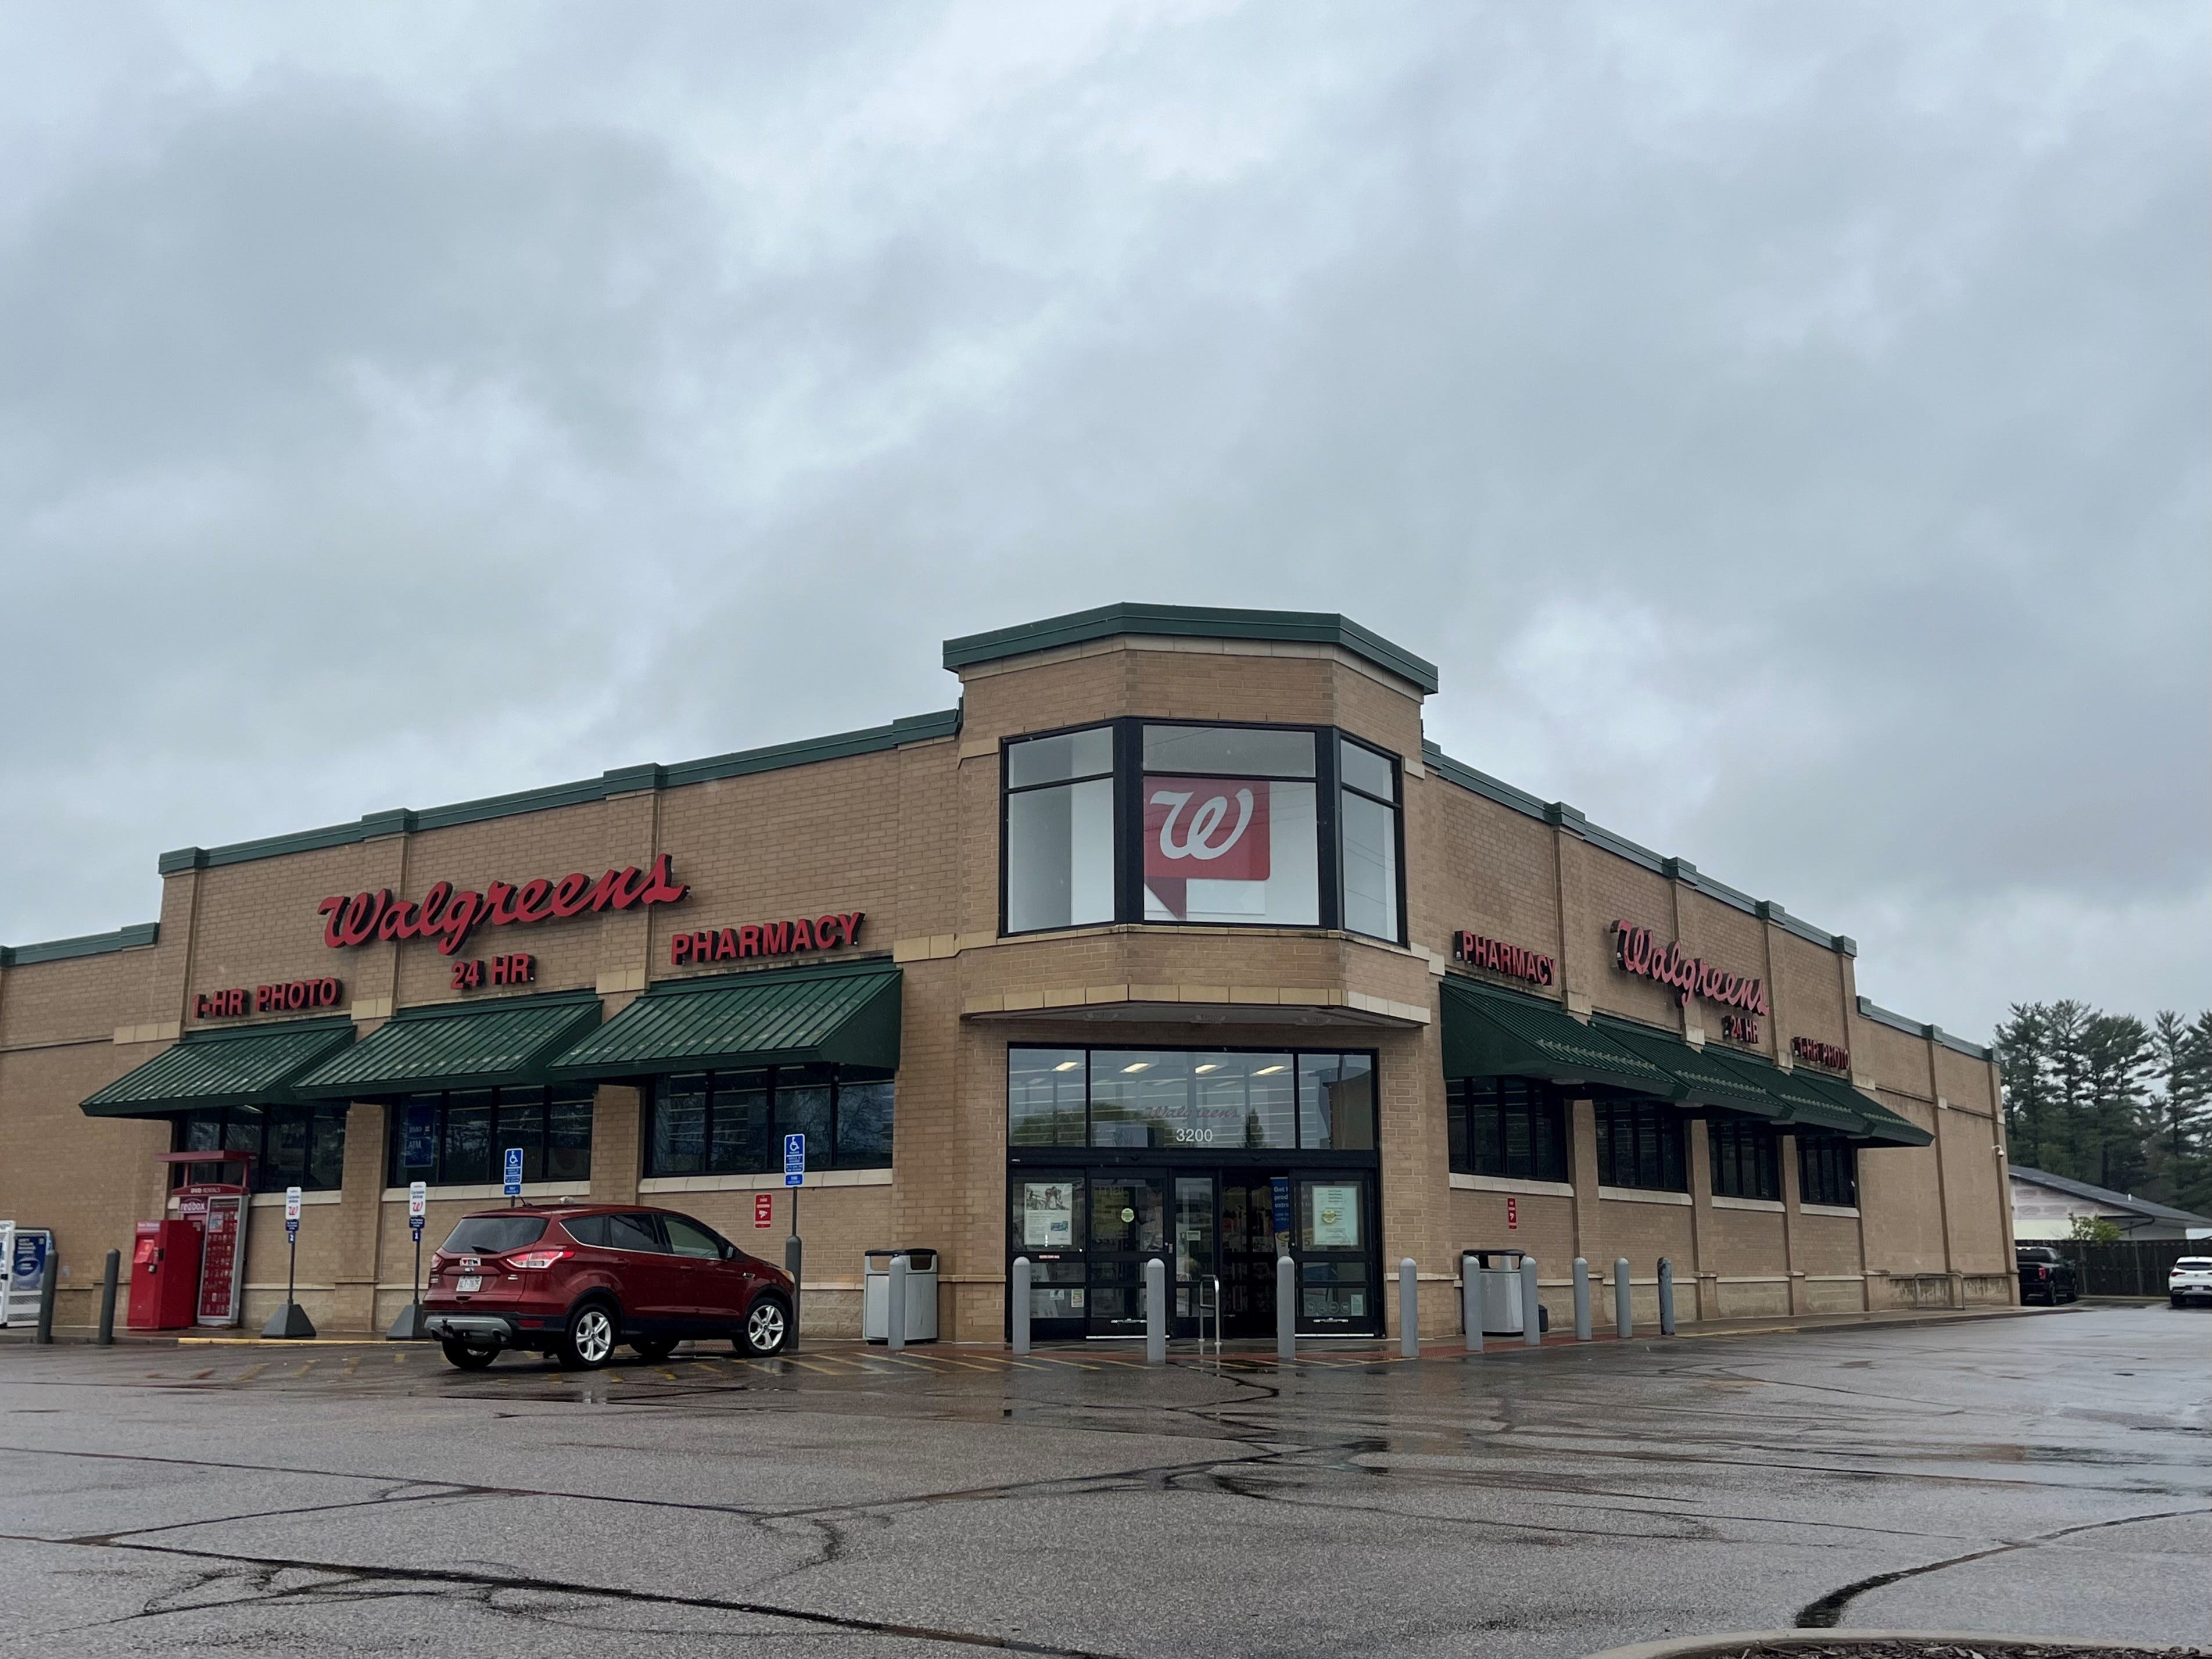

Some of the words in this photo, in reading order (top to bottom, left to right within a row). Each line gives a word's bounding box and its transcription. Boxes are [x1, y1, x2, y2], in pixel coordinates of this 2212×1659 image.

[1150, 787, 1254, 860] W
[318, 854, 687, 955] Walgreens
[671, 912, 863, 965] PHARMACY
[451, 961, 481, 989] 24
[492, 954, 530, 984] HR
[1461, 930, 1557, 986] PHARMACY
[1616, 919, 1770, 1016] Walgreens
[192, 988, 245, 1018] 1-HR
[256, 977, 338, 1012] PHOTO
[1730, 1015, 1743, 1039] 24
[1745, 1018, 1759, 1044] HR
[1823, 1043, 1850, 1070] PHOTO
[1145, 1105, 1241, 1123] Walgreens
[408, 1140, 422, 1149] ATM
[1176, 1128, 1213, 1142] 3200
[180, 1201, 205, 1212] redbox
